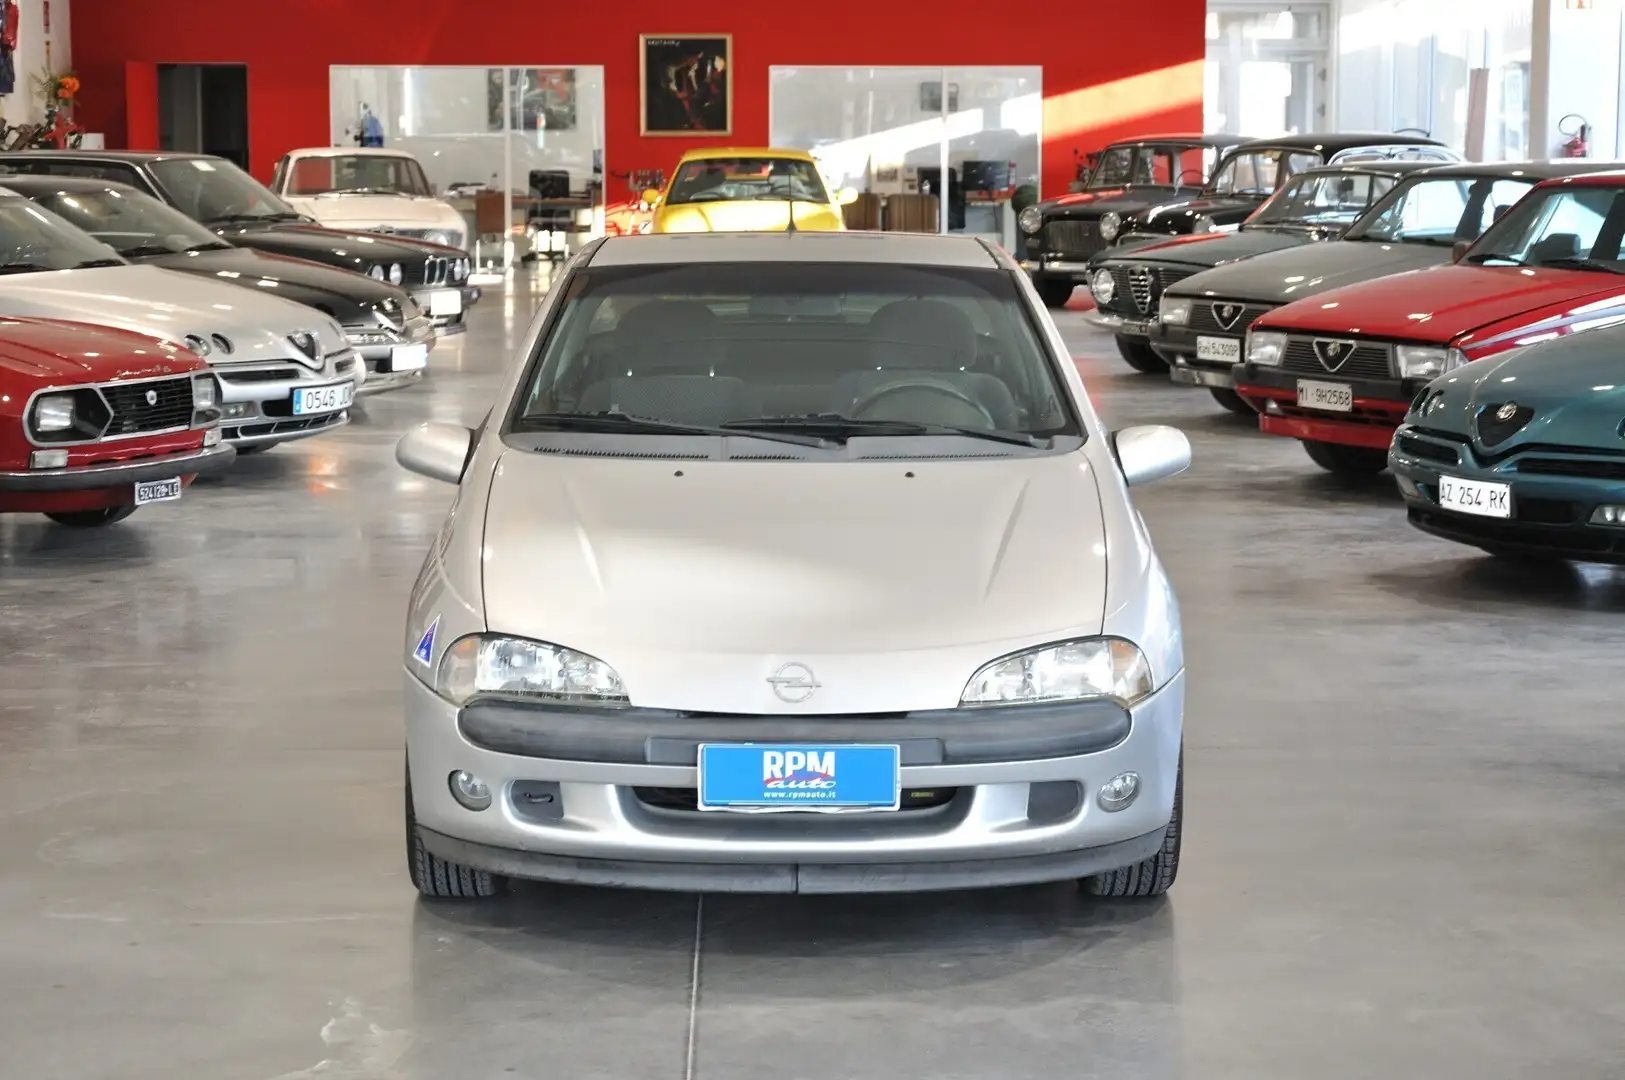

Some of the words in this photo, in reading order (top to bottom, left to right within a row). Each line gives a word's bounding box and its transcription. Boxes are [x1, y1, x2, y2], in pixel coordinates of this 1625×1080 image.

[306, 389, 336, 409] 0546
[1315, 388, 1350, 406] 9H2568
[1440, 483, 1453, 502] AZ
[1459, 486, 1483, 506] 254
[1489, 490, 1507, 510] RK
[763, 751, 835, 780] RPM
[766, 779, 837, 789] auto
[763, 790, 836, 799] www.rpmauto.it
